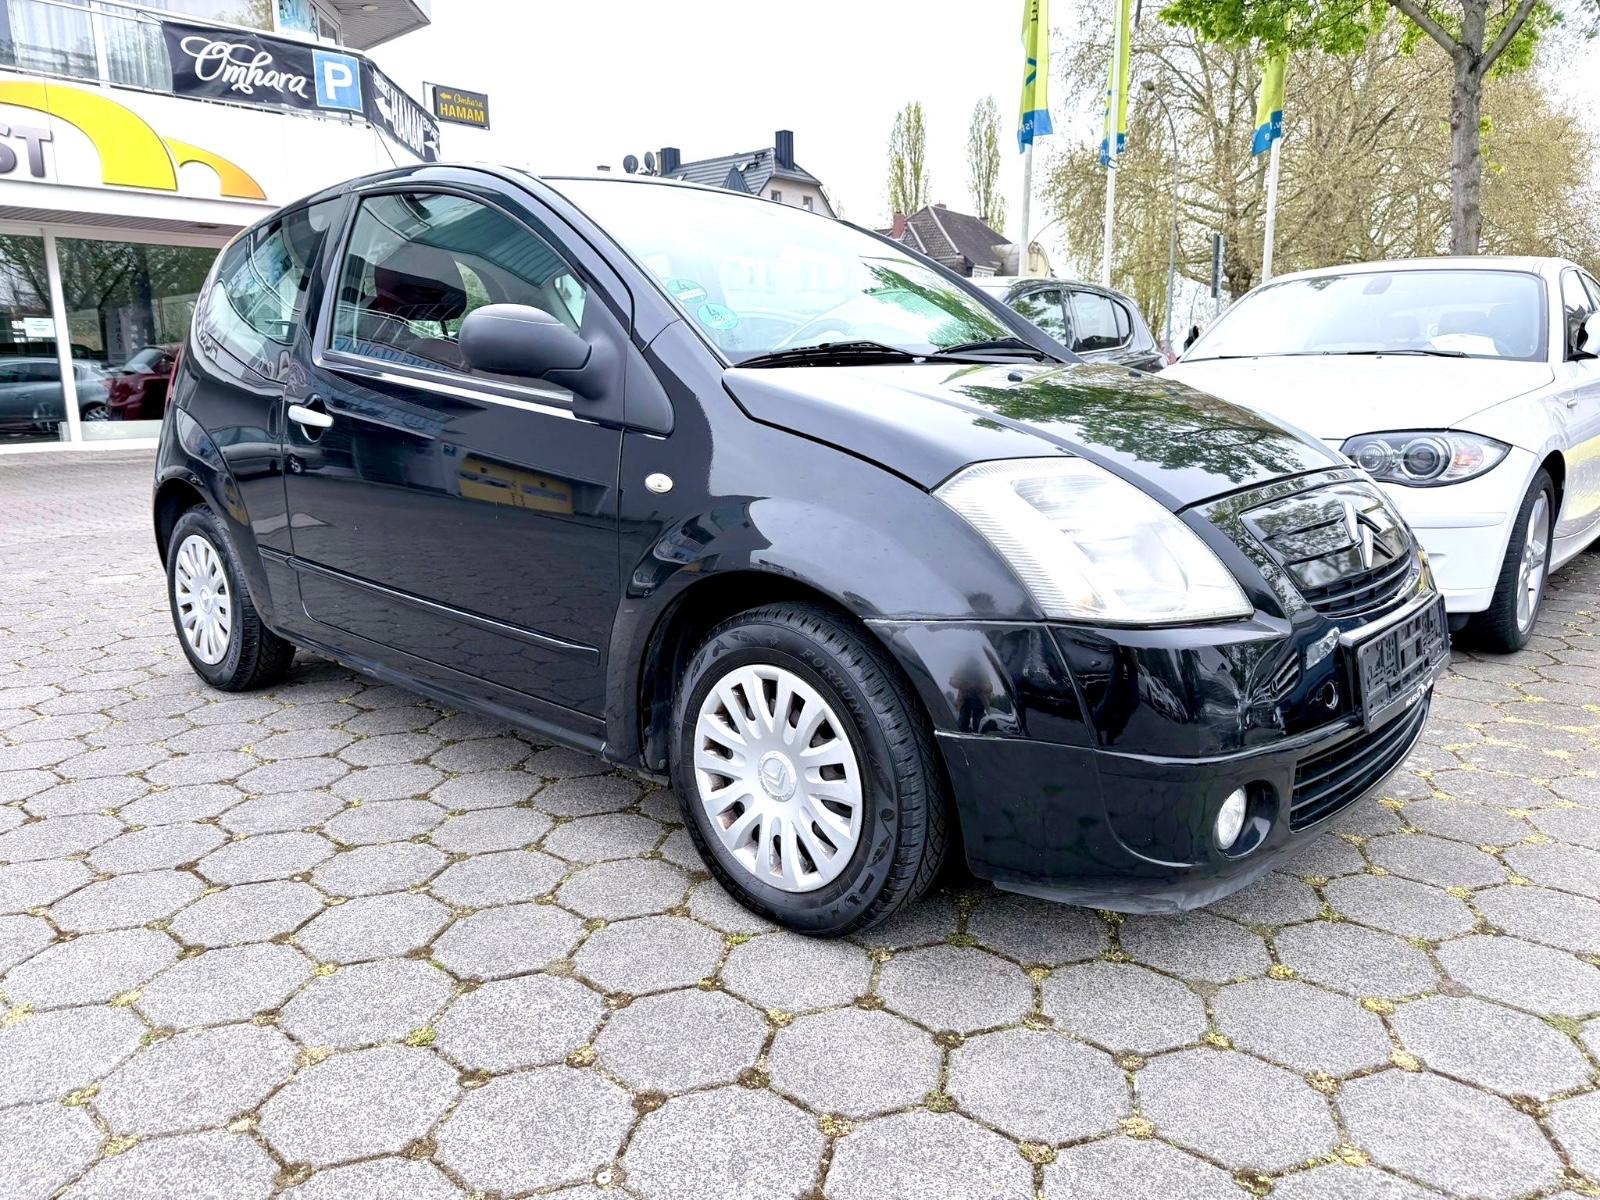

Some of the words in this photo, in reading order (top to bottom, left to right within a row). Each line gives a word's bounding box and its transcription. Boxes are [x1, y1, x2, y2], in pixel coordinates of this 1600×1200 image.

[180, 36, 309, 98] Omhara
[323, 61, 353, 101] P
[440, 102, 485, 122] HAMAM
